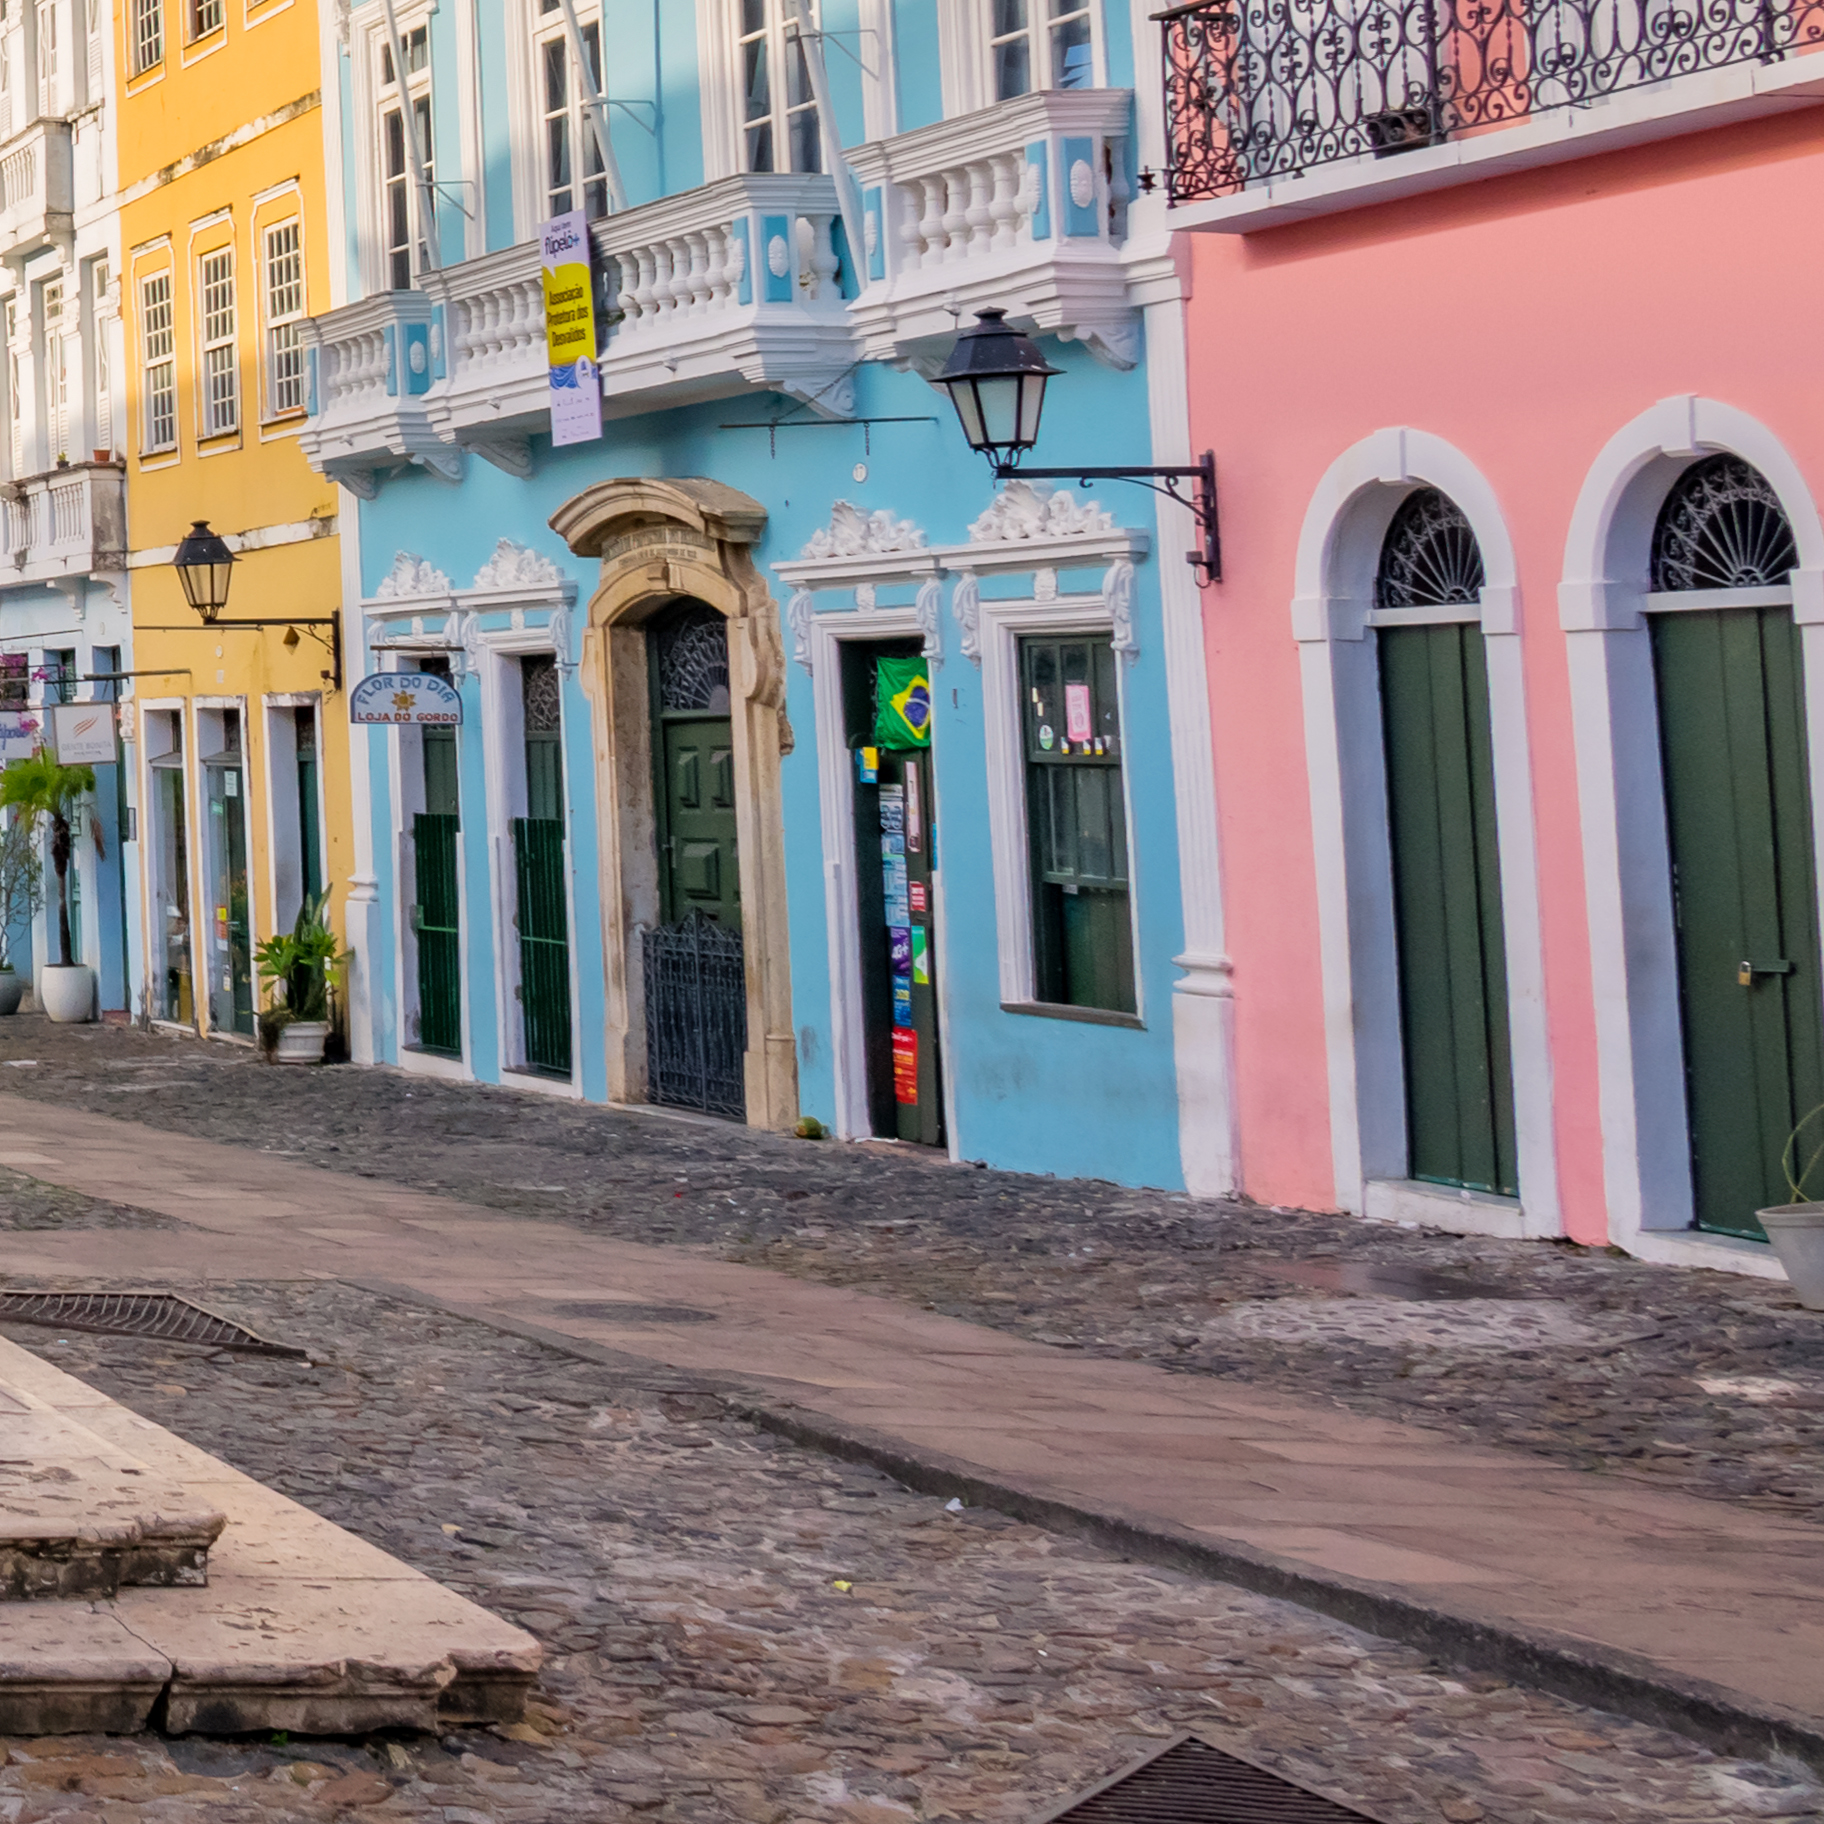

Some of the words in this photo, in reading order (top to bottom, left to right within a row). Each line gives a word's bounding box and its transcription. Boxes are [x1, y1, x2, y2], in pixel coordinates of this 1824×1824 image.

[549, 283, 583, 307] Associação
[547, 309, 576, 327] Protetora
[577, 304, 589, 319] dos
[357, 677, 395, 705] FLOR
[400, 677, 422, 689] DO
[426, 679, 456, 704] DIA
[357, 712, 392, 722] LOJA
[394, 713, 412, 722] DO
[416, 712, 459, 722] GORDO
